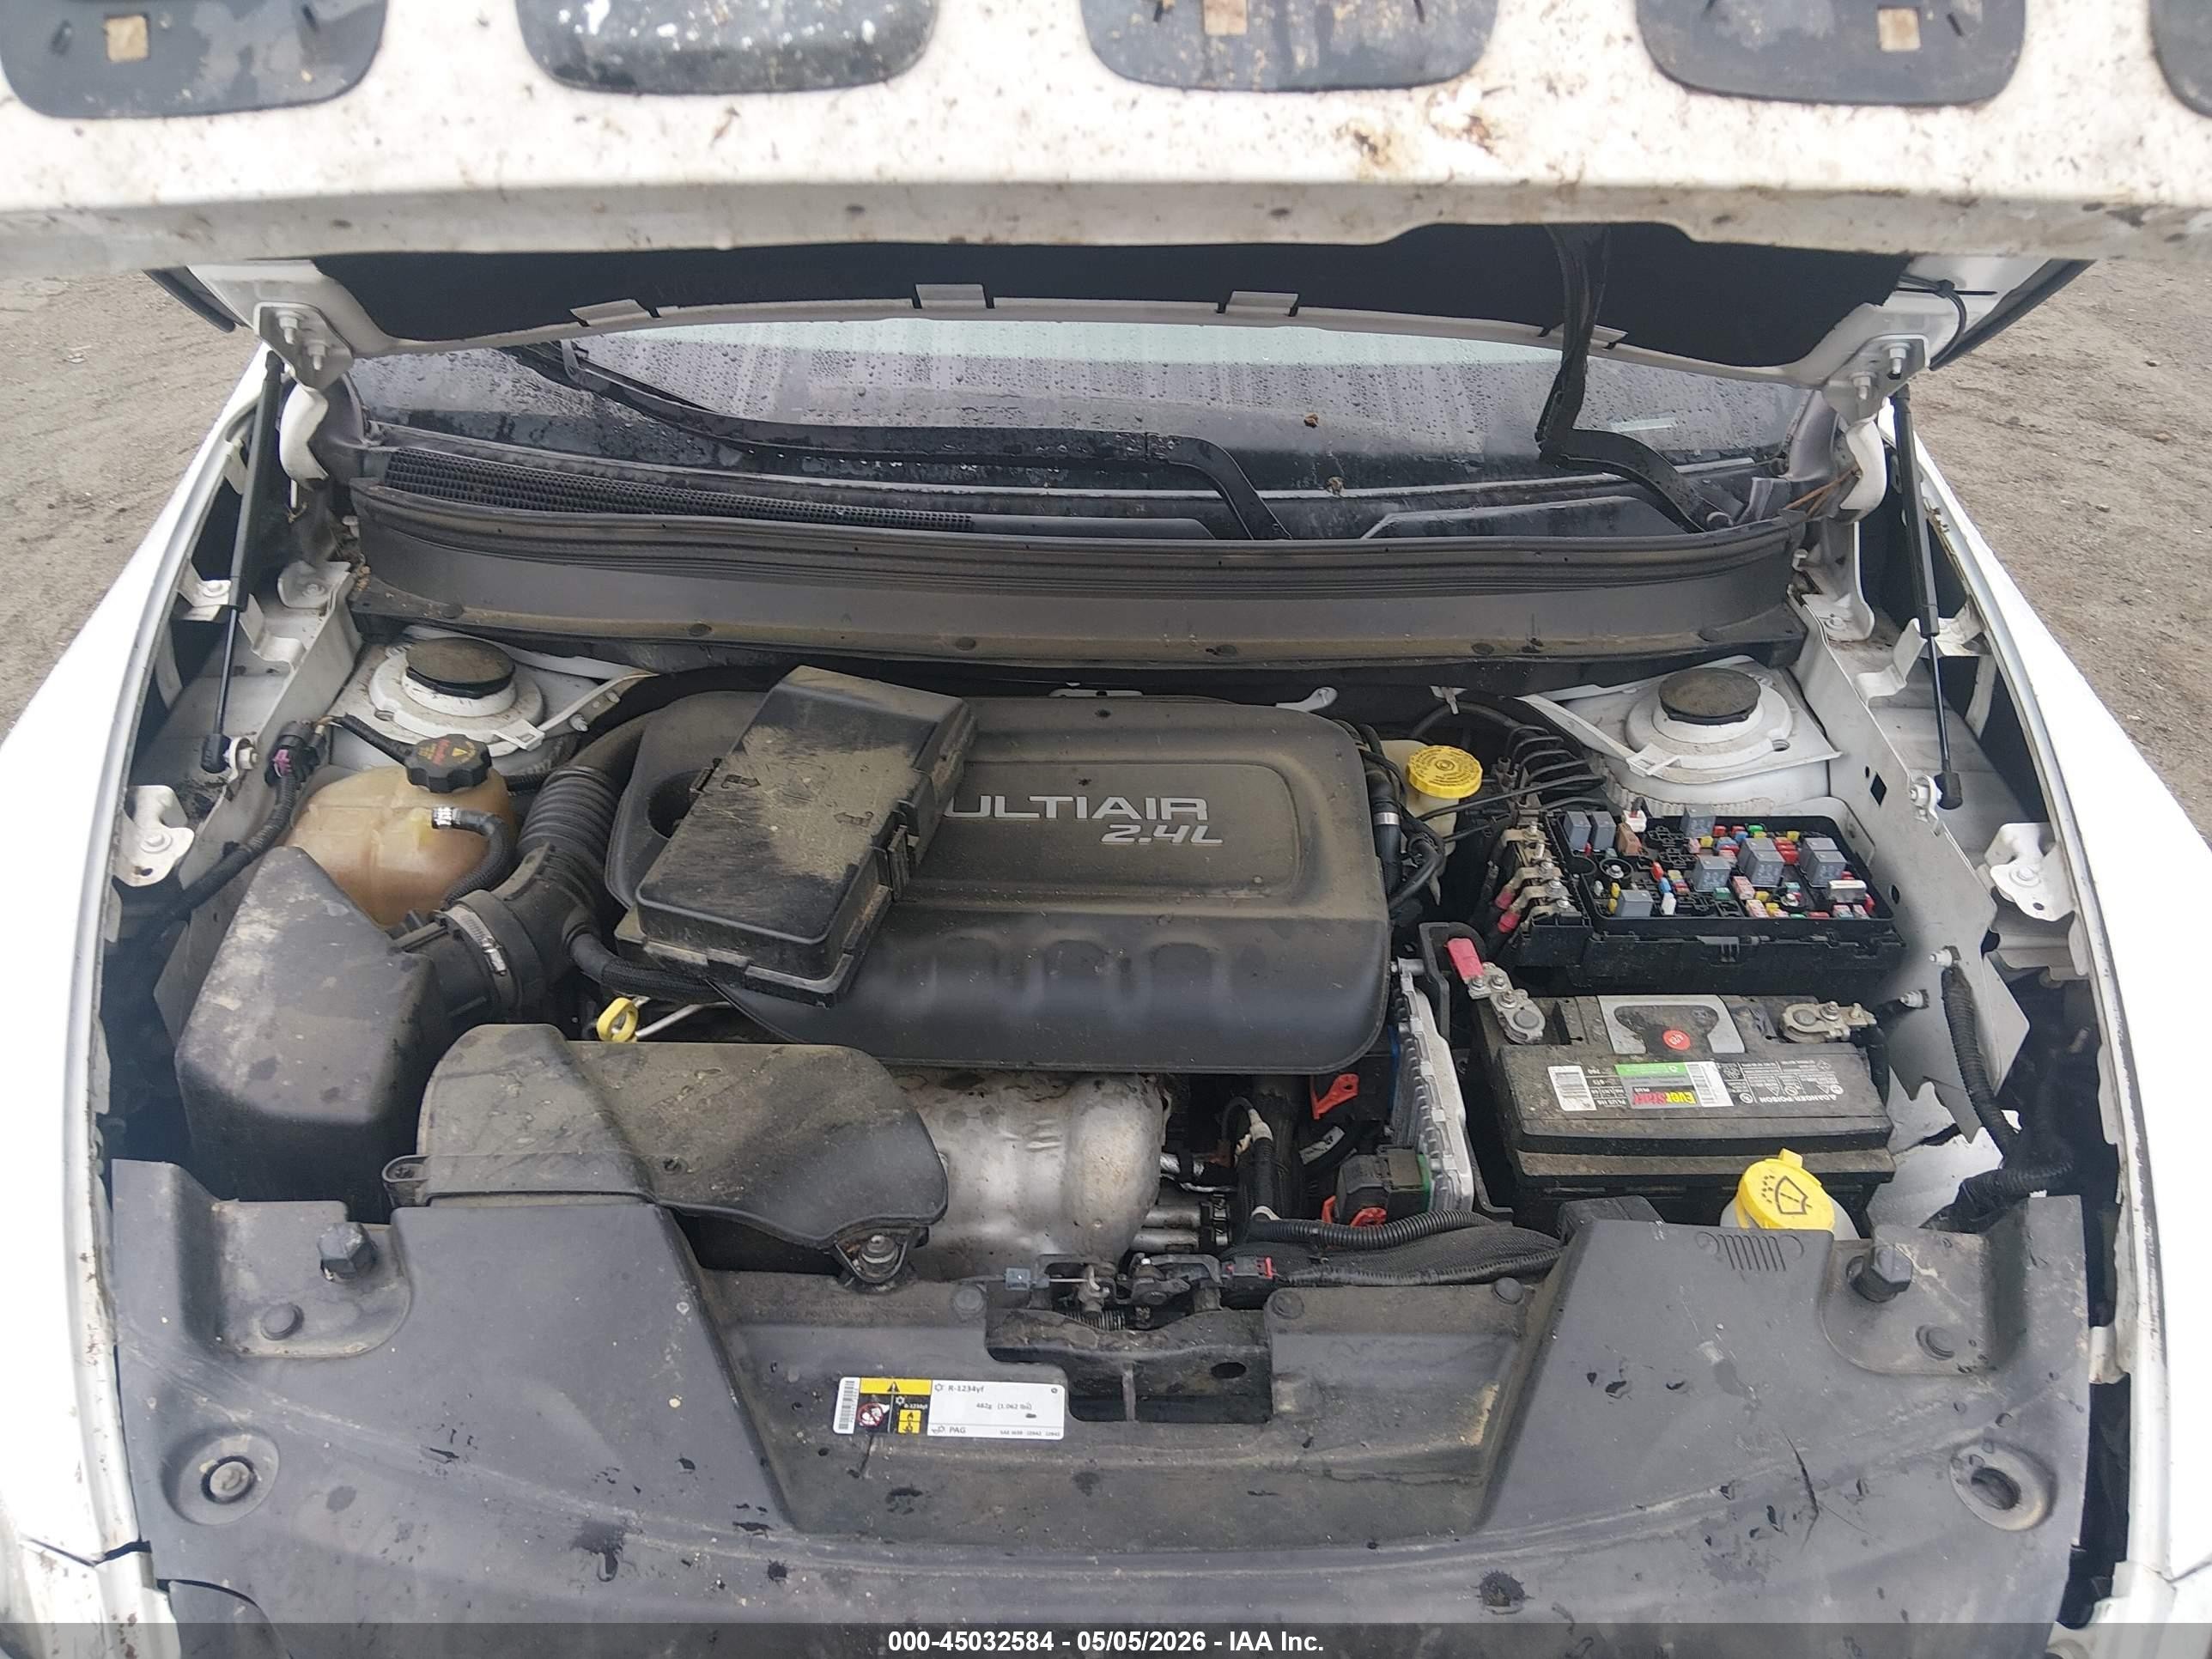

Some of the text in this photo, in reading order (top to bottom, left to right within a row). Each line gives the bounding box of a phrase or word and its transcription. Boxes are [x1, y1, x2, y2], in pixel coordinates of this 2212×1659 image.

[945, 795, 1209, 821] ULTIAIR
[1100, 824, 1224, 844] 2.4L
[1632, 1091, 1698, 1105] EverStart
[947, 1385, 984, 1395] R-1234yf
[949, 1425, 967, 1434] PAG
